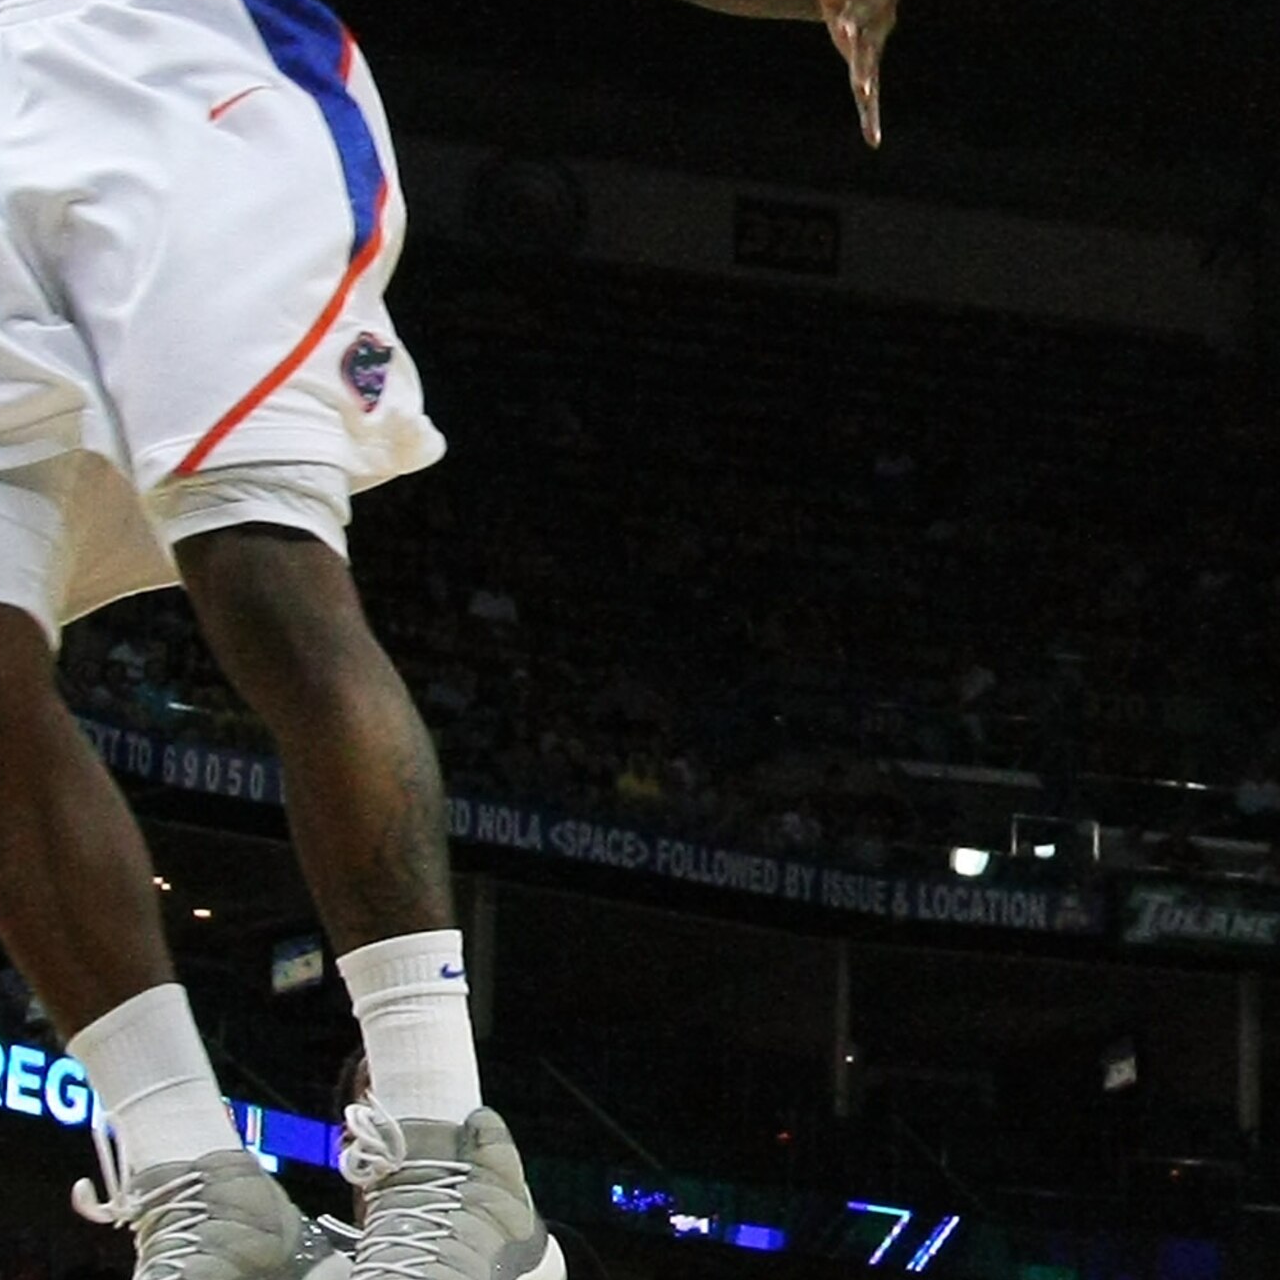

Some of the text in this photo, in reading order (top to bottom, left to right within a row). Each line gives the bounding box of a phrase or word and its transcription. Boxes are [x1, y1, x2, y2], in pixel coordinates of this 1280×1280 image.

[122, 732, 151, 778] TO
[161, 744, 265, 801] 69050
[477, 802, 543, 852] NOLA
[656, 838, 779, 894] FOLLOWED
[784, 862, 817, 903] BY
[822, 870, 889, 915] ISSUE
[891, 883, 910, 918] &
[919, 884, 1048, 929] LOCATION
